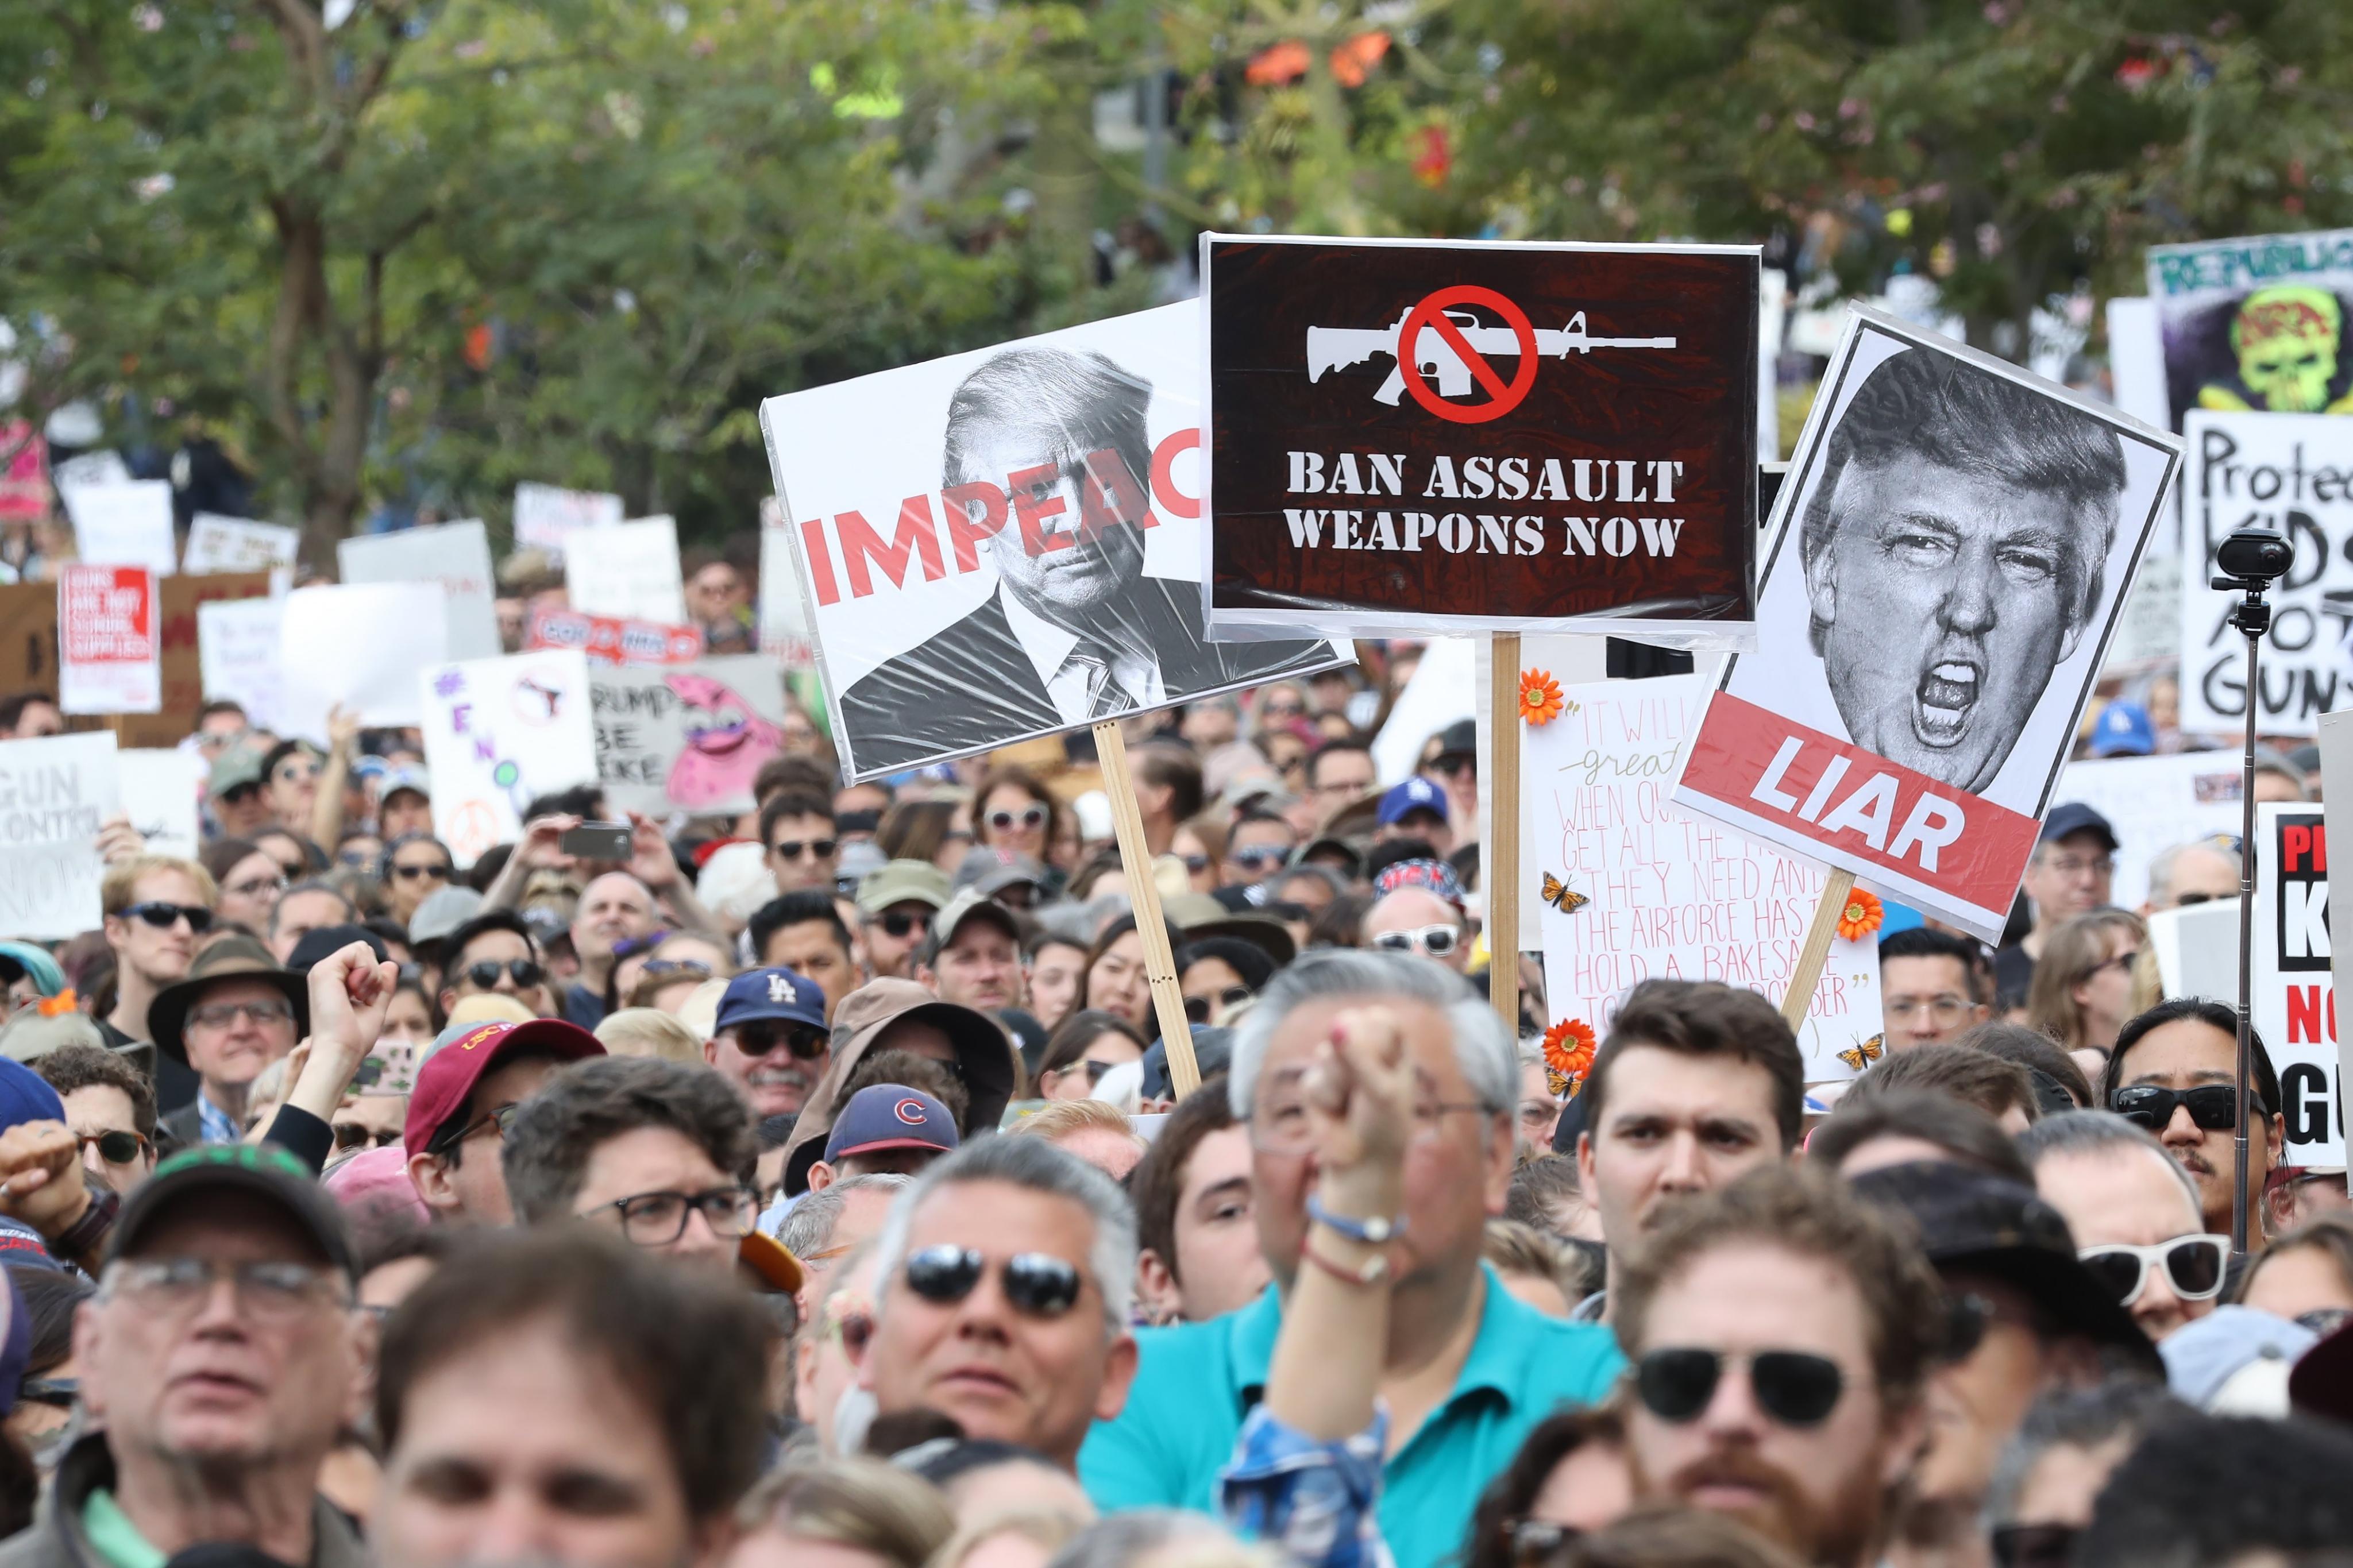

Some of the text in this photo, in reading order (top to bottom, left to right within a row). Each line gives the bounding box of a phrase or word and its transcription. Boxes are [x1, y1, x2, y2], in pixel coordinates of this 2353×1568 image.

[1287, 451, 1683, 503] BAN ASSAULT
[1283, 508, 1685, 557] WEAPONS NOW
[2202, 654, 2353, 720] GUN
[1554, 784, 1625, 831] WHEN
[1750, 735, 1966, 874] LIAR
[1557, 818, 1726, 871] GET ALL THE
[1582, 863, 1671, 912] THEY
[1694, 858, 1761, 902] NEED
[1573, 910, 1622, 954] THE
[1630, 902, 1740, 950] AIRFORCE
[1753, 898, 1803, 940] HAS
[766, 974, 796, 1004] LA
[1575, 953, 1648, 995] HOLD
[1703, 940, 1839, 984] BAKESAE
[461, 1025, 500, 1051] USC
[894, 1098, 928, 1125] C
